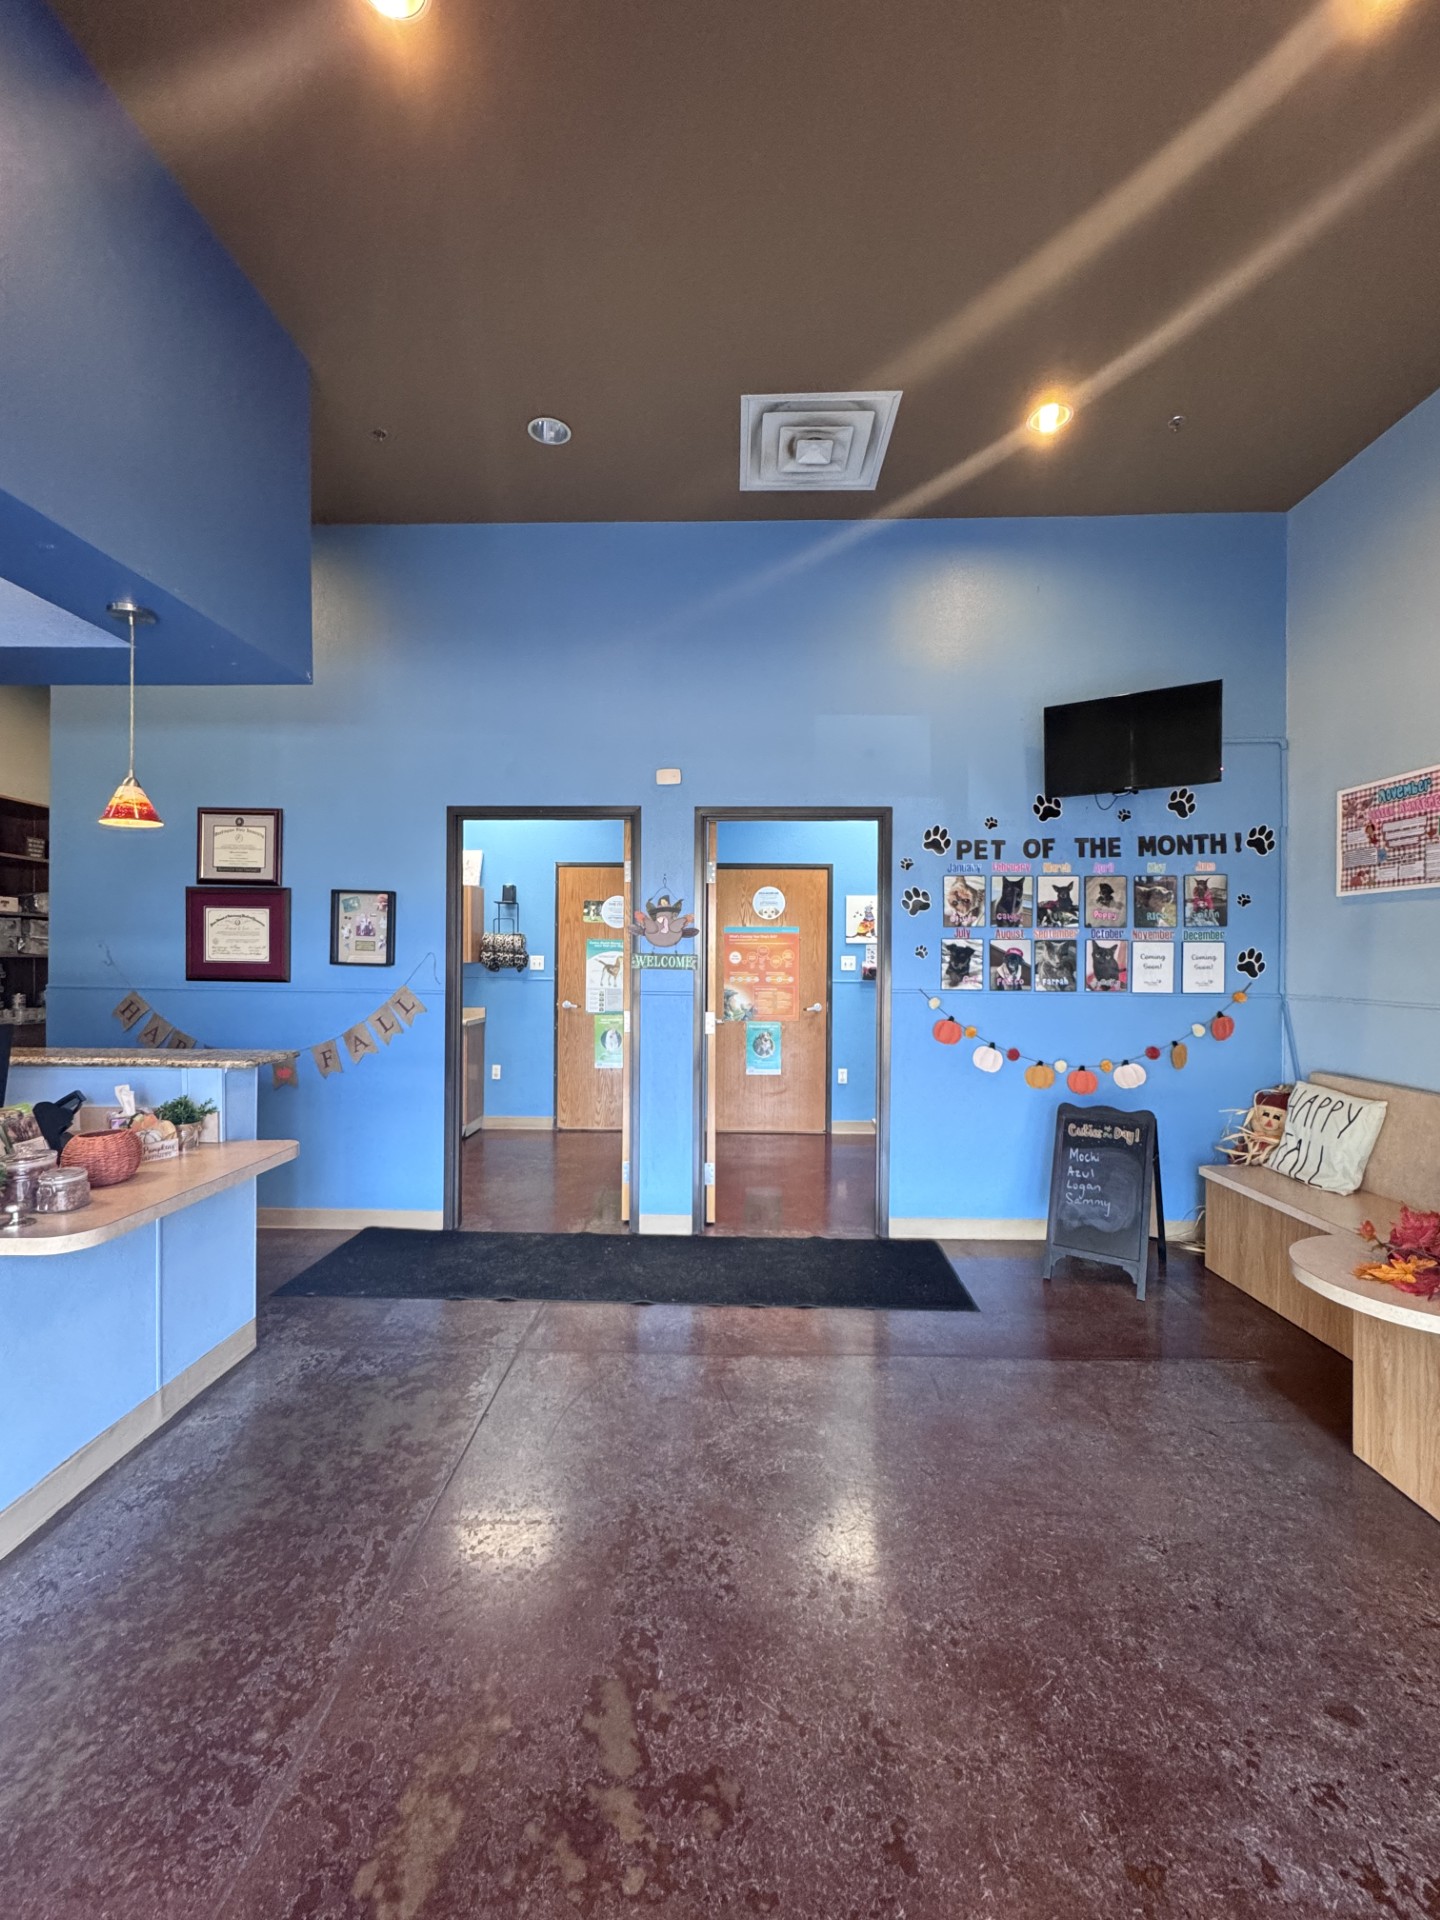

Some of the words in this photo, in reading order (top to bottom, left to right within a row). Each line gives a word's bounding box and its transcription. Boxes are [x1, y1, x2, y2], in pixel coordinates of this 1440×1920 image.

[957, 839, 1006, 860] PET
[1023, 838, 1056, 859] OF
[1074, 837, 1121, 858] THE
[947, 862, 982, 874] January
[992, 861, 1031, 874] February
[954, 928, 971, 939] July
[995, 929, 1024, 939] August
[1034, 928, 1080, 940] September
[1091, 929, 1124, 939] October
[1132, 930, 1175, 940] November
[1184, 930, 1225, 940] December
[635, 954, 693, 969] WELCOME
[1140, 953, 1166, 962] Coming
[1191, 953, 1217, 962] Coming
[320, 997, 416, 1070] FALL
[1288, 1088, 1363, 1139] HAPPY
[1069, 1147, 1100, 1162] Mochi
[1271, 1132, 1322, 1188] FALL
[1067, 1165, 1095, 1178] Azul
[1066, 1179, 1101, 1199] Logan
[1065, 1192, 1111, 1218] Sammy
